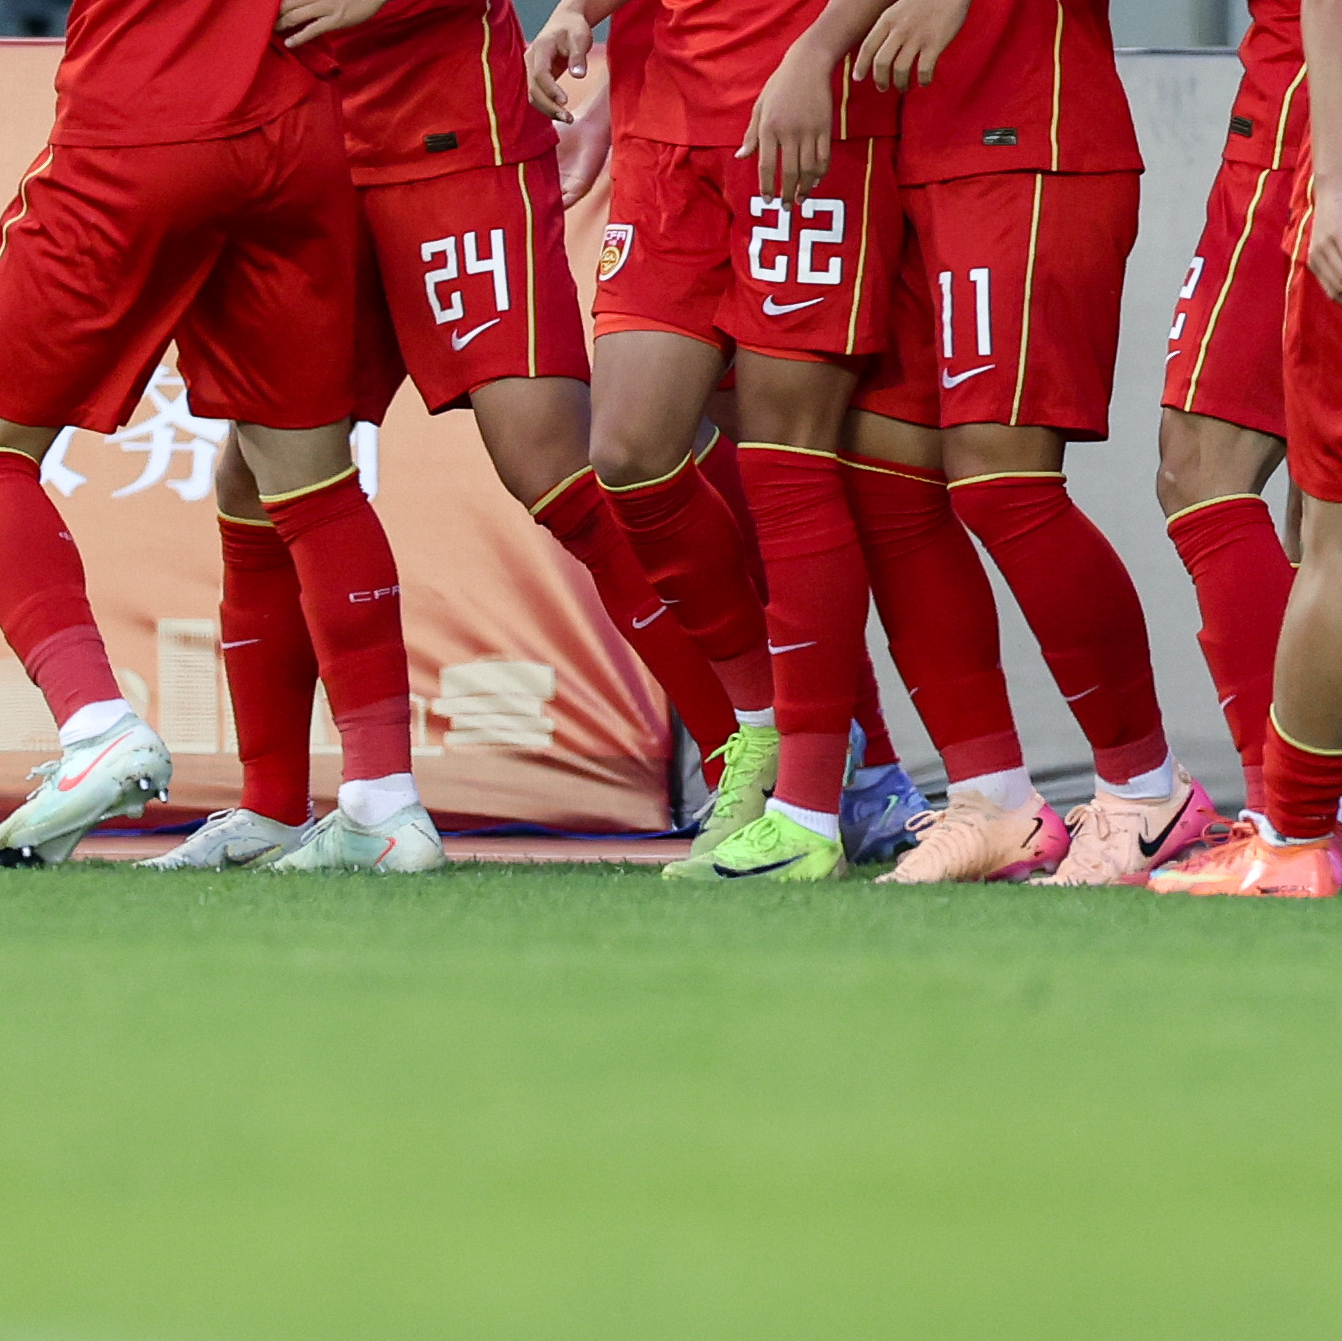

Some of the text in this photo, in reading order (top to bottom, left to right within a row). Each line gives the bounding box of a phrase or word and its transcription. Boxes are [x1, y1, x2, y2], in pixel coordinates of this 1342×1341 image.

[421, 228, 510, 325] 24
[748, 196, 845, 285] 22
[939, 268, 991, 358] 11
